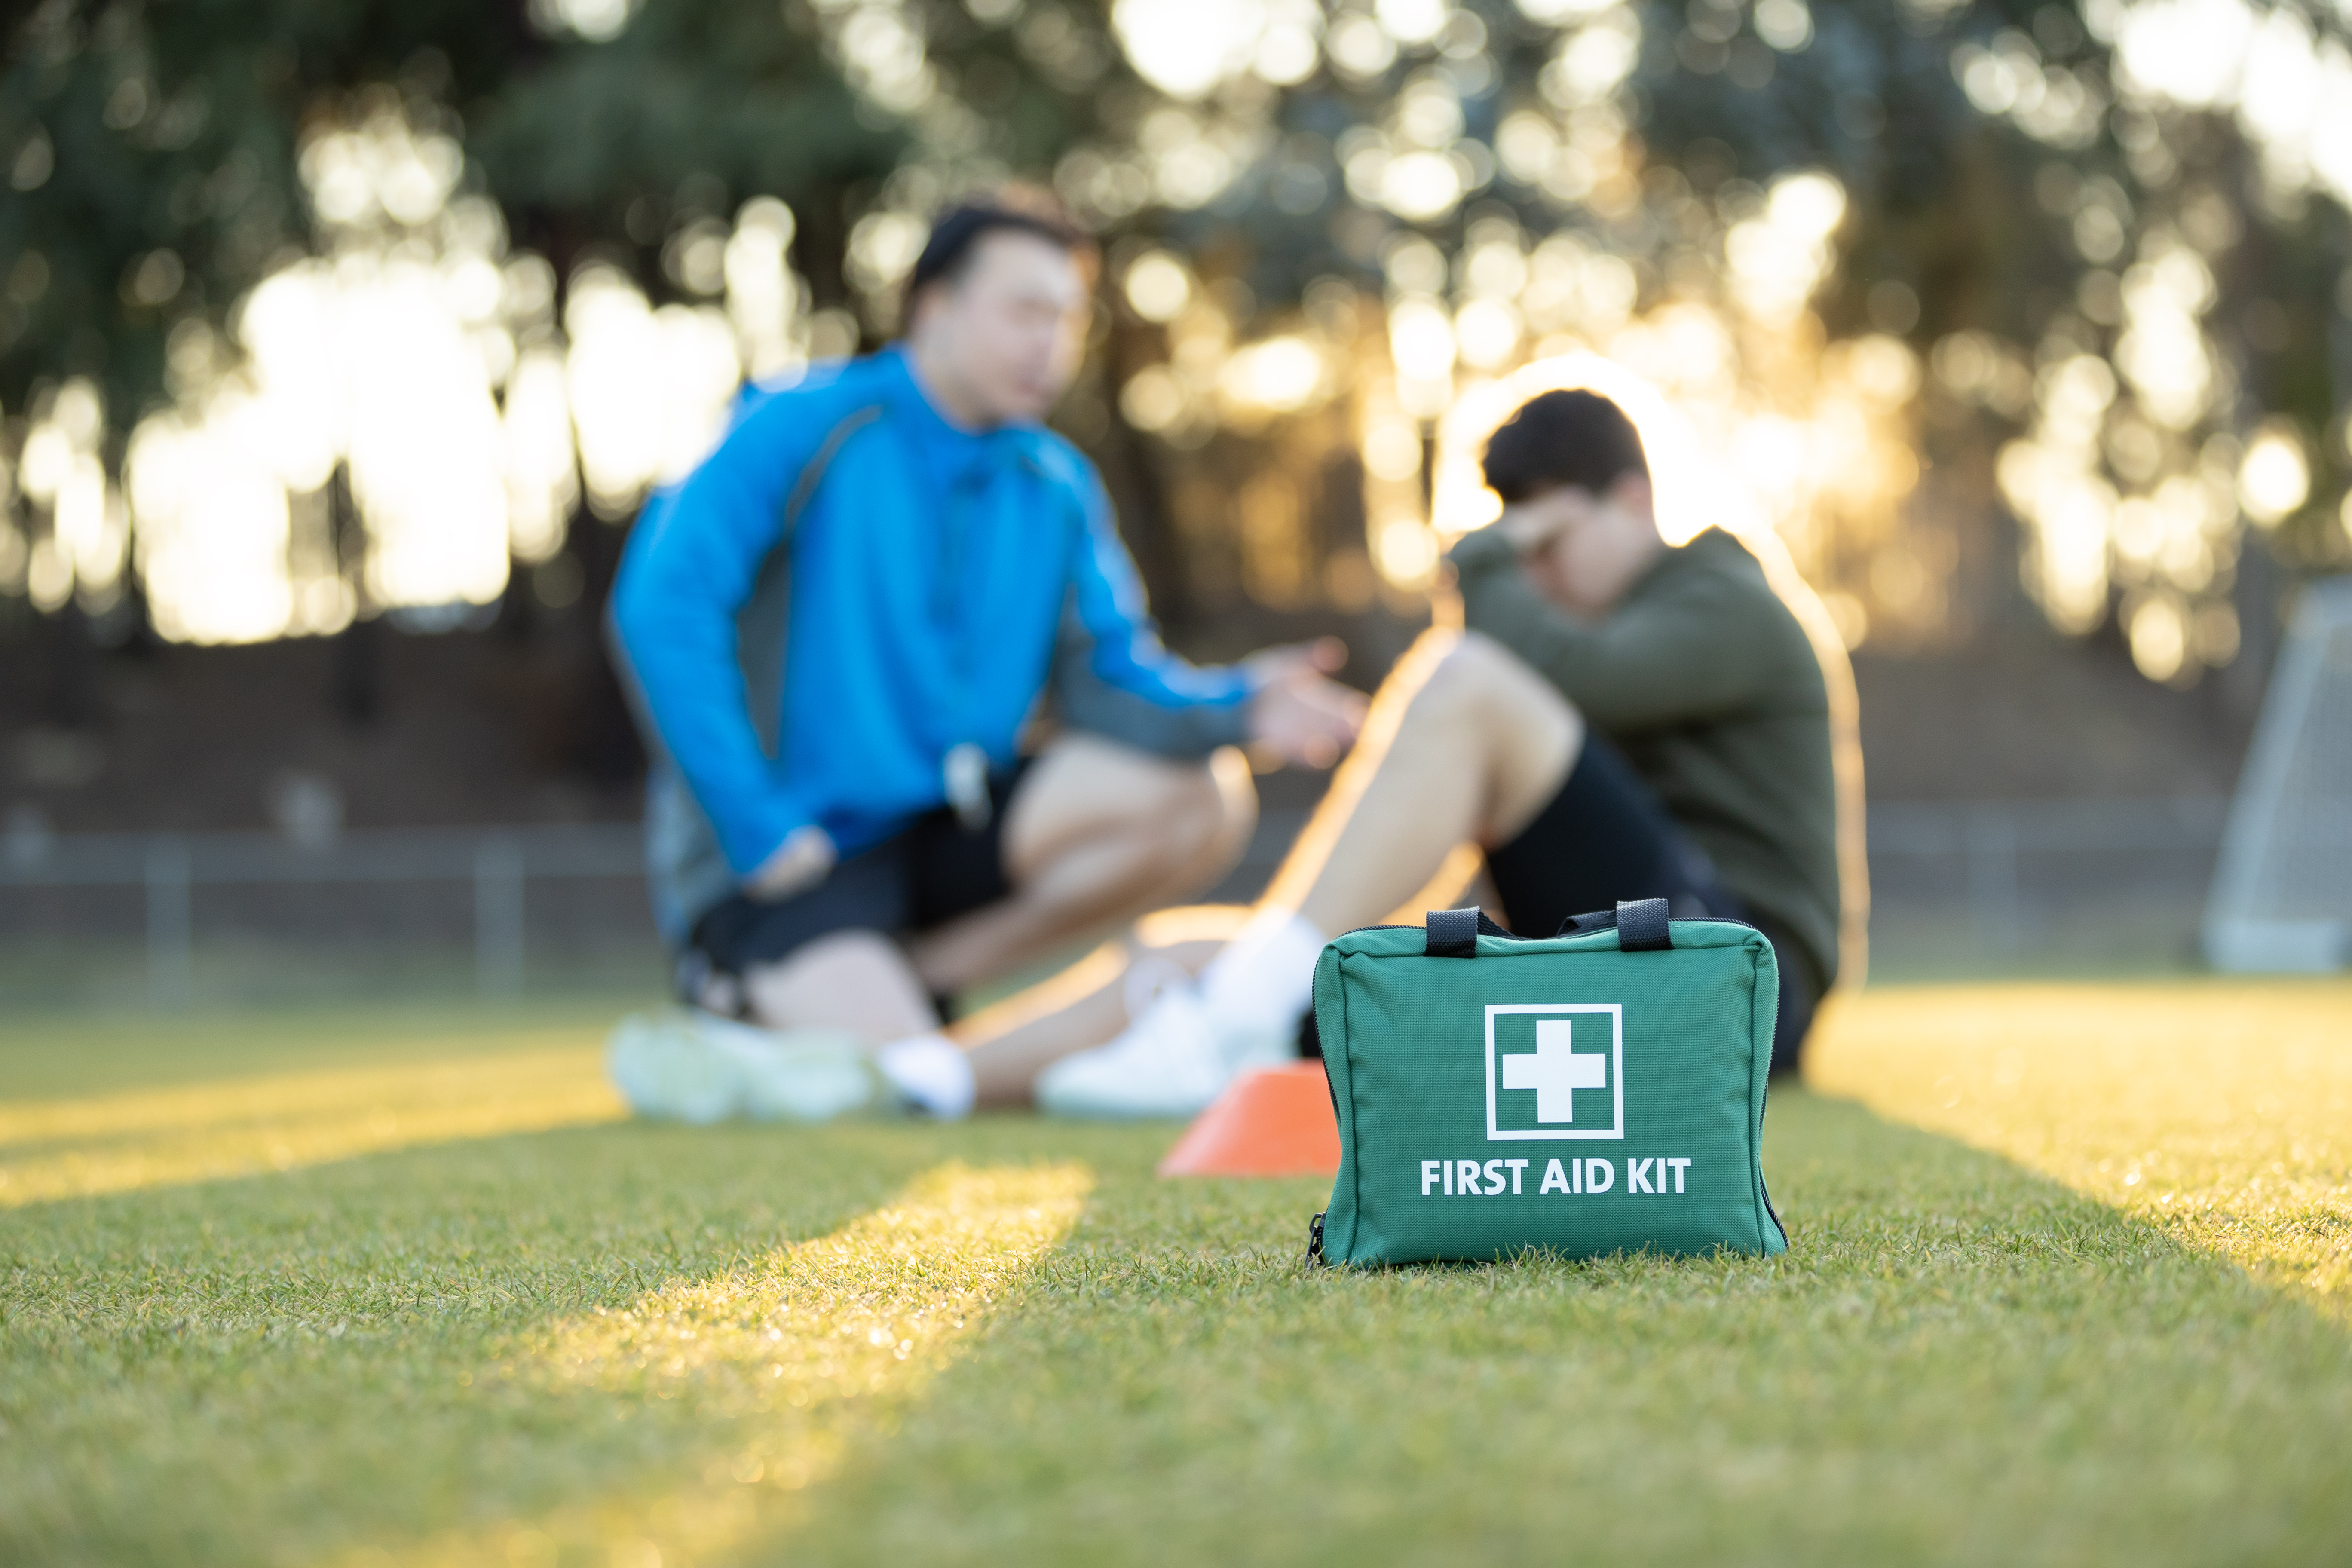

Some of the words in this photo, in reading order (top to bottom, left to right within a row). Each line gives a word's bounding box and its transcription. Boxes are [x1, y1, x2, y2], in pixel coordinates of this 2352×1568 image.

[1421, 1159, 1529, 1195] FIRST
[1539, 1158, 1614, 1194] AID
[1628, 1158, 1691, 1194] KIT
